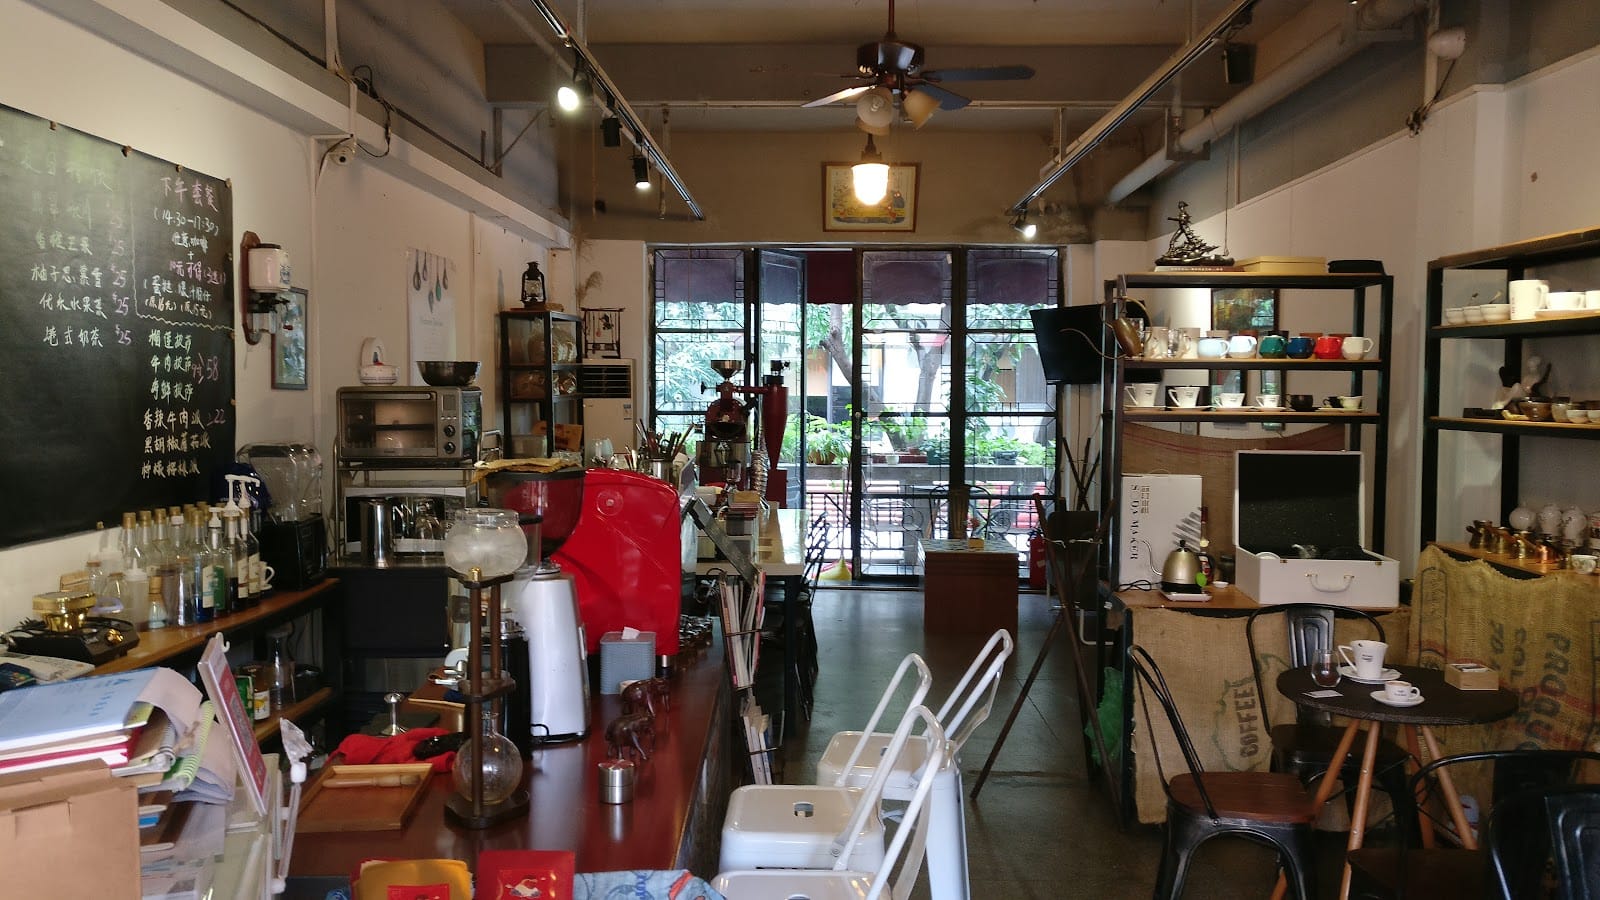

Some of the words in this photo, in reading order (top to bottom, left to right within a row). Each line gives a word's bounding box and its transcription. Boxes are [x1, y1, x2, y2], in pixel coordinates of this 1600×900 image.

[160, 176, 219, 212] 下午套餐
[1130, 520, 1140, 560] MAKER
[1233, 686, 1259, 758] COFFEE
